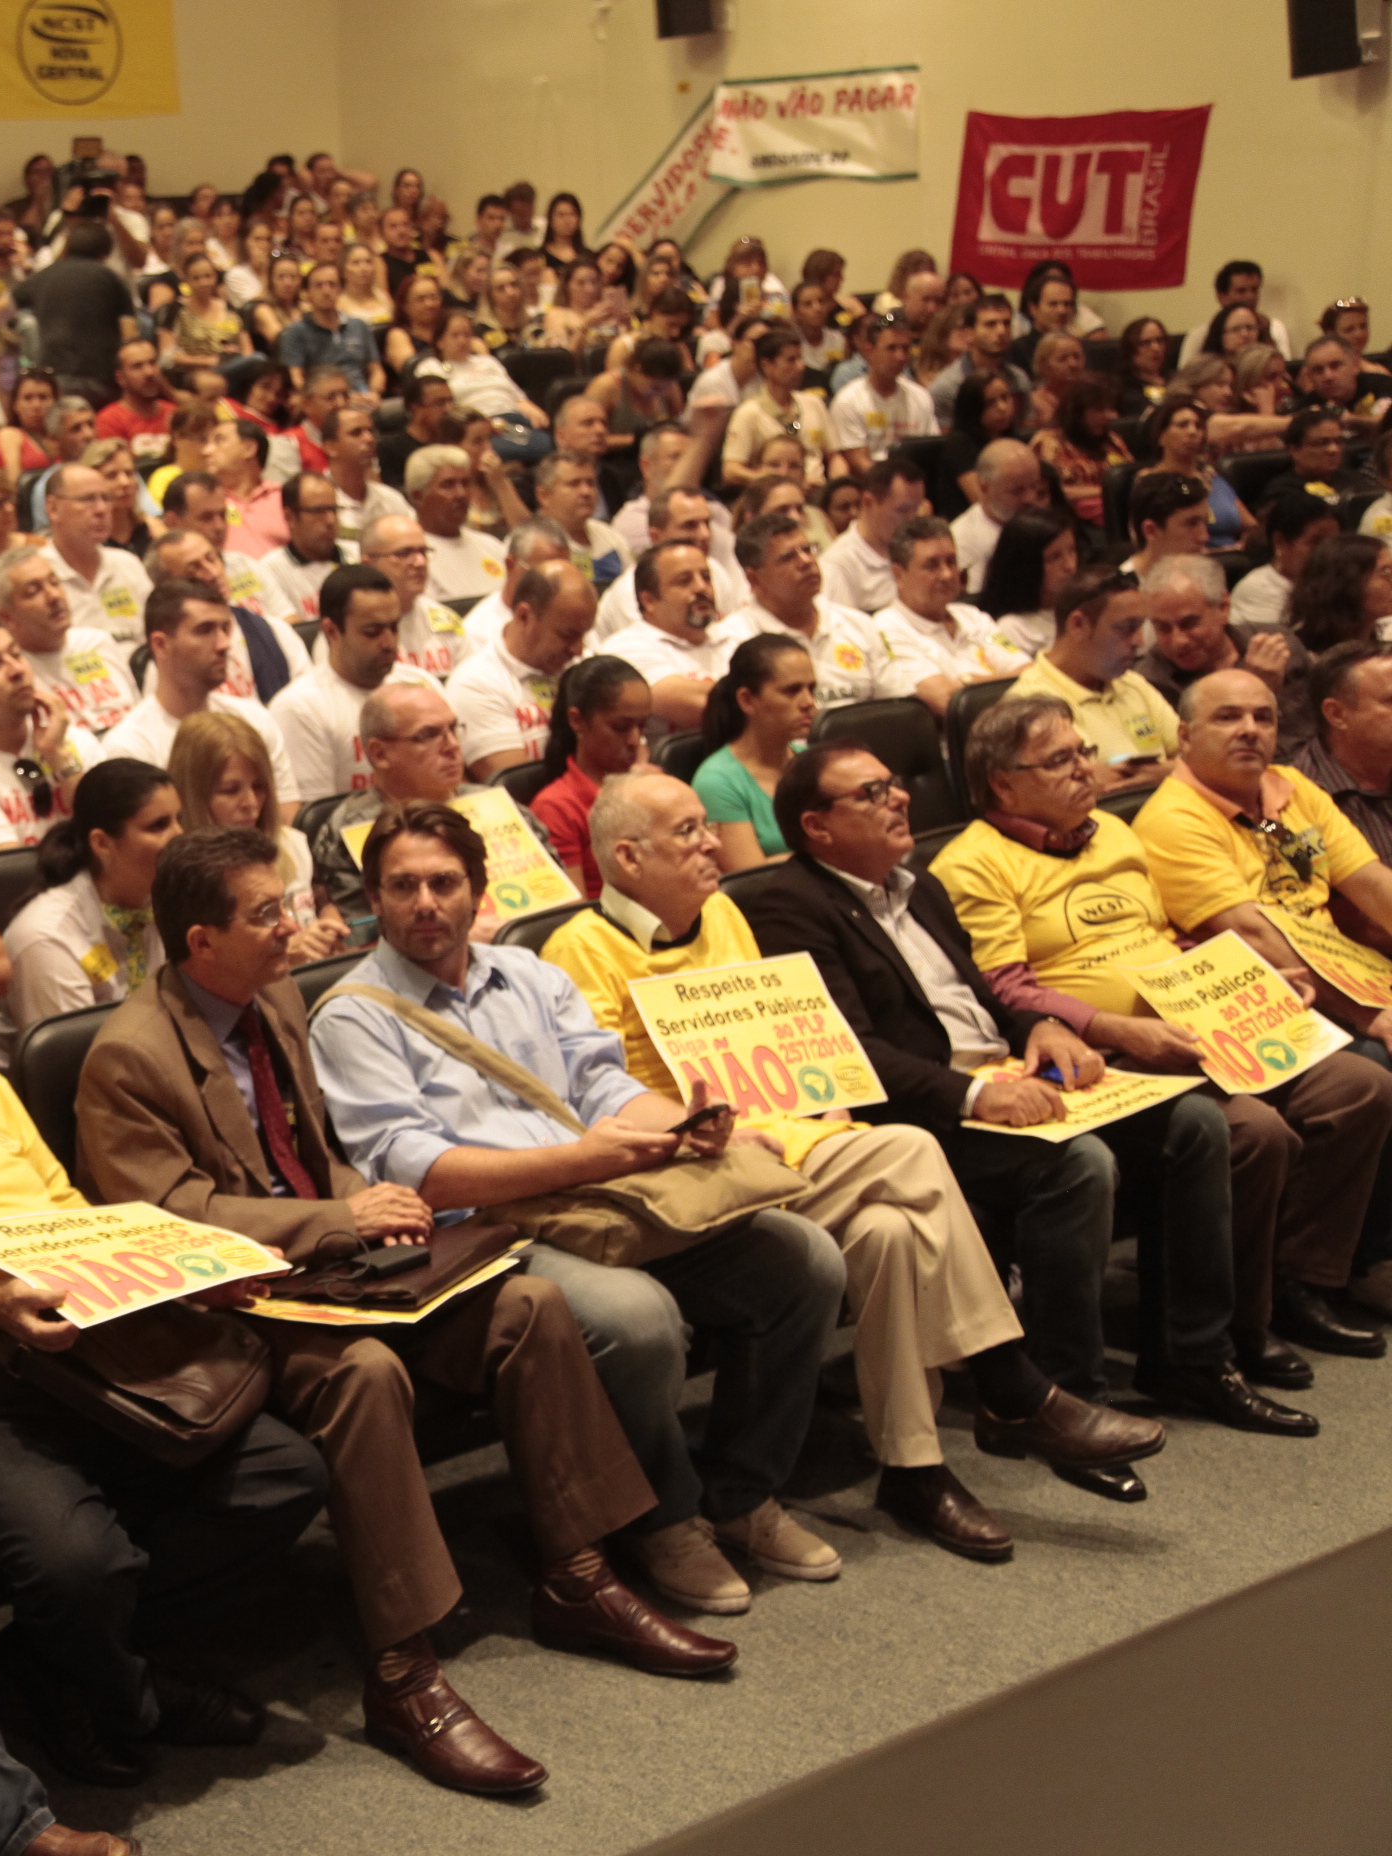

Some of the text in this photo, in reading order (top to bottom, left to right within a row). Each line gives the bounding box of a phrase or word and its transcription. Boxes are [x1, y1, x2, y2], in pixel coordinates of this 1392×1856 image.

[775, 88, 825, 119] VÃO
[832, 84, 916, 115] PAGAR
[990, 150, 1146, 240] CUT
[674, 971, 783, 1003] Respeite os
[1193, 959, 1216, 977] os
[1196, 963, 1267, 1003] Públicos
[656, 994, 828, 1037] Servidores Públicos
[1219, 983, 1270, 1023] ao PLP
[1229, 995, 1304, 1044] 257/2016
[665, 1013, 826, 1057] Diga ao PLP
[679, 1036, 800, 1120] NÃO
[778, 1032, 855, 1065] 257/2016
[95, 1212, 125, 1226] os
[102, 1219, 188, 1241] Públicos
[27, 1250, 187, 1319] NÃO
